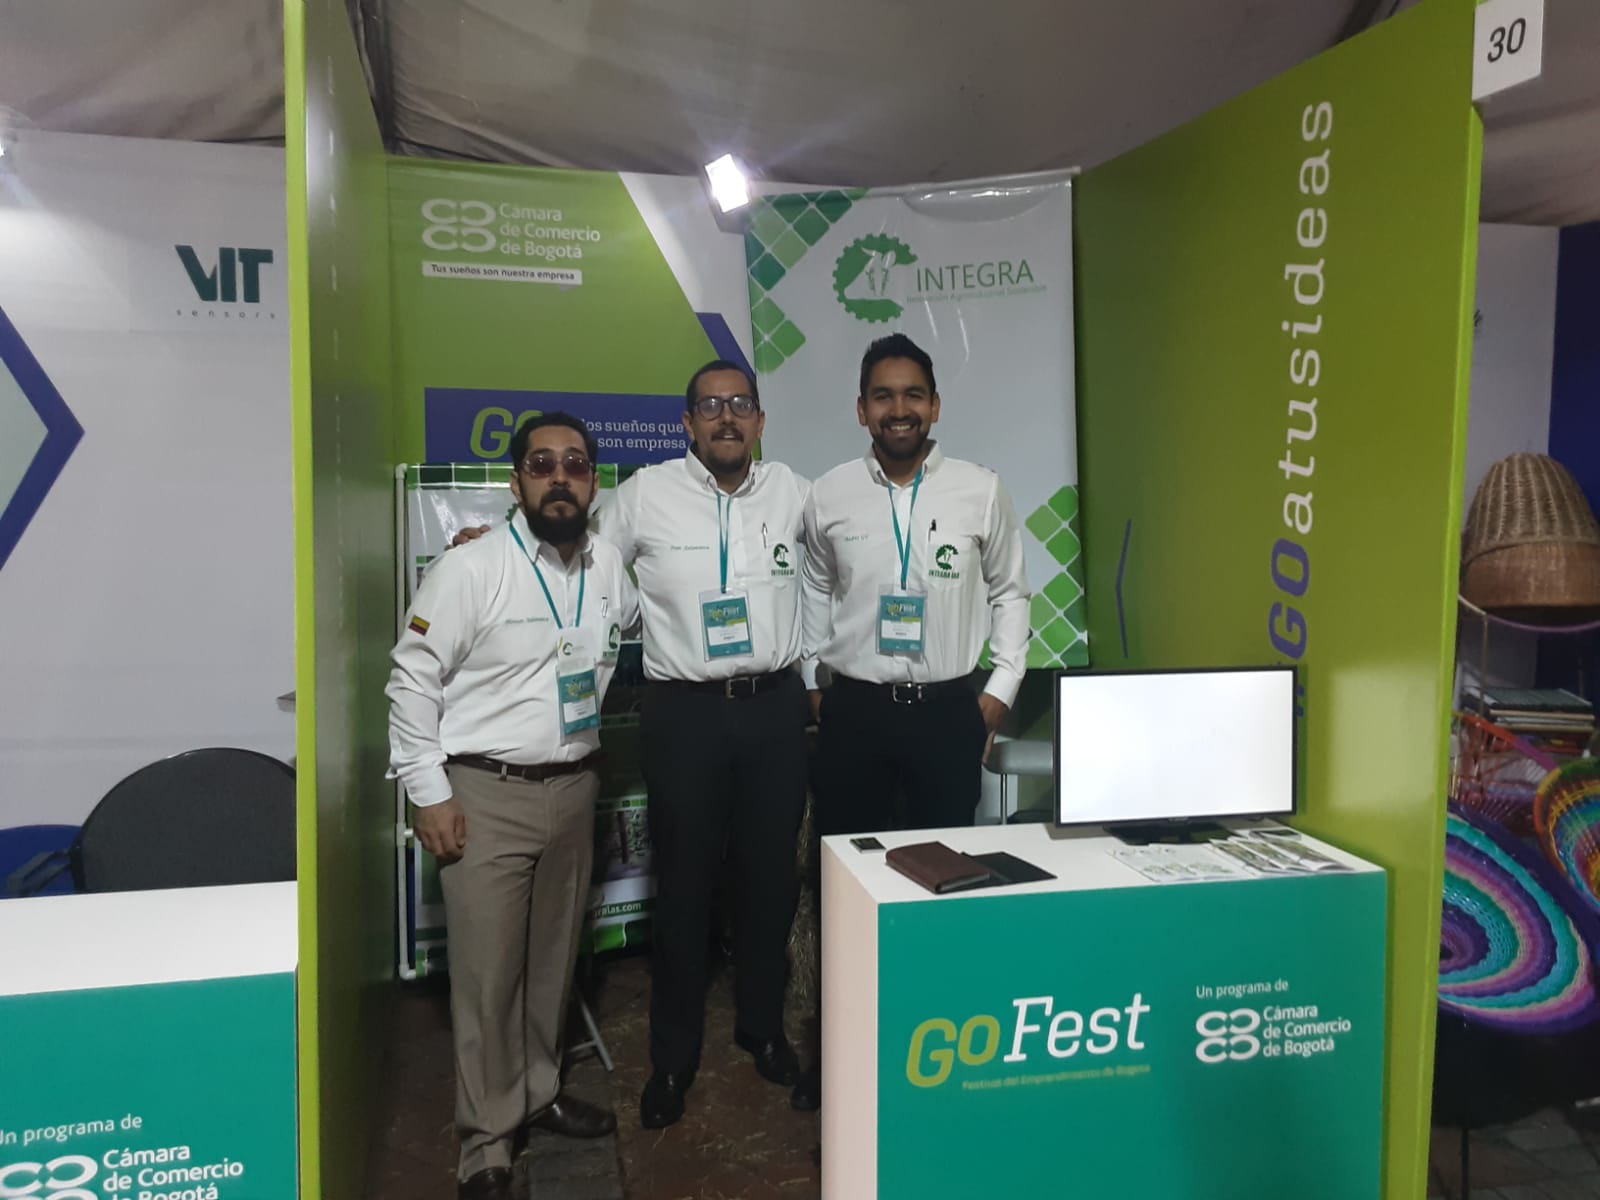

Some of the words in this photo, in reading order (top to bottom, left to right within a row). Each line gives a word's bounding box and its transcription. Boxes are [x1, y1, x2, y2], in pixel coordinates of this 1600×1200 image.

[1487, 18, 1526, 63] 30
[500, 203, 562, 221] Cámara
[500, 222, 520, 236] de
[525, 224, 600, 242] Comercio
[501, 240, 521, 255] de
[525, 241, 582, 261] Bogotá
[174, 244, 273, 303] VIT
[432, 264, 447, 273] Tus
[450, 265, 480, 276] sueños
[483, 268, 499, 276] son
[501, 269, 535, 279] nuestra
[537, 272, 575, 281] empresa
[917, 259, 1034, 292] INTEGRA
[176, 309, 276, 319] sensors
[1268, 102, 1333, 717] GOatusideas
[605, 420, 656, 432] sueños
[659, 423, 684, 436] que
[598, 438, 624, 448] son
[626, 439, 687, 452] empresa
[1196, 984, 1213, 998] Un
[1216, 981, 1271, 998] programa
[1275, 978, 1288, 991] de
[1263, 1005, 1318, 1021] Cámara
[1263, 1023, 1281, 1039] de
[1284, 1017, 1351, 1037] Comercio
[1263, 1041, 1280, 1057] de
[1284, 1037, 1334, 1057] Bogotá
[24, 1118, 114, 1147] programa
[121, 1114, 143, 1130] de
[103, 1145, 190, 1169] Cámara
[103, 1171, 132, 1193] de
[138, 1158, 243, 1187] Comercio
